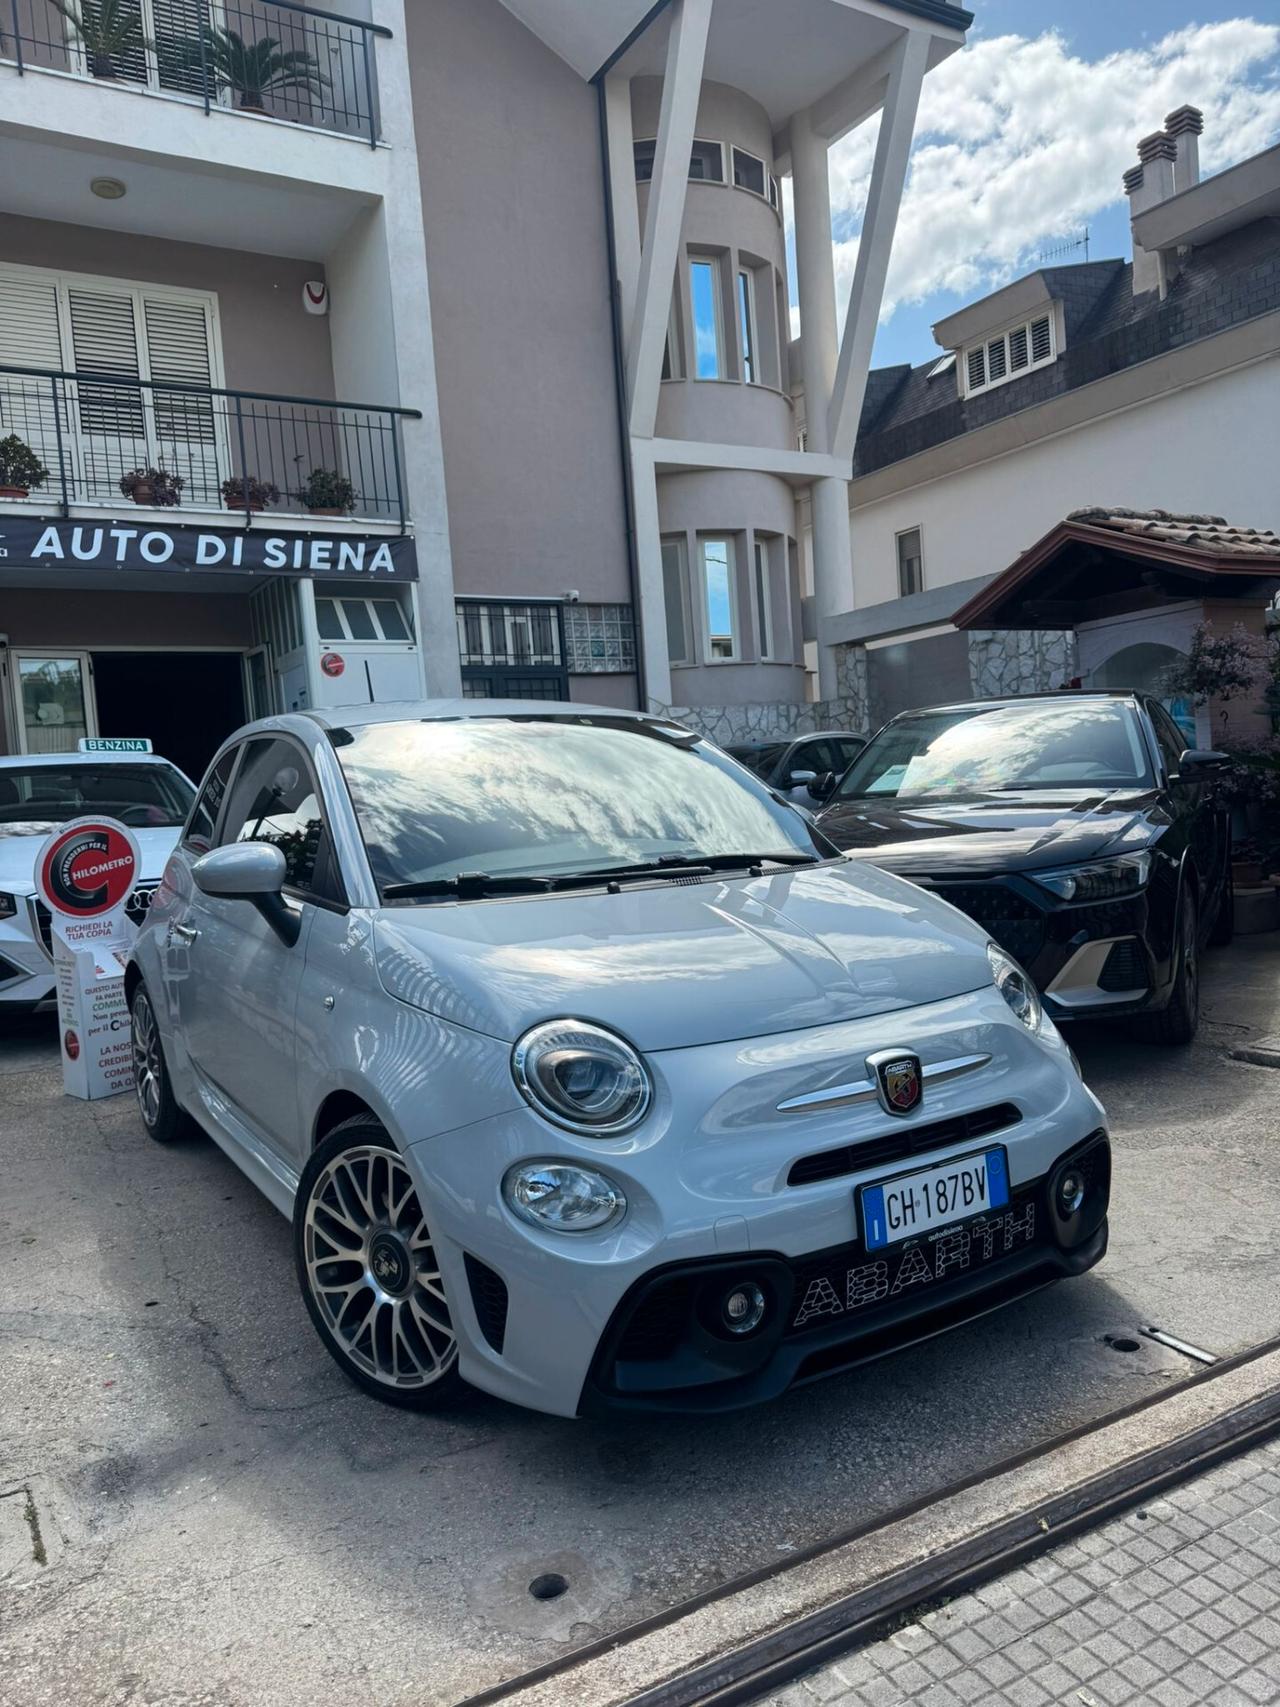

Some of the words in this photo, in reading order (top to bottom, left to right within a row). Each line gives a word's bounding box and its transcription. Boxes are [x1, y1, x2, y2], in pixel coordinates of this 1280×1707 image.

[30, 526, 175, 564] AUTO
[196, 534, 243, 566] DI
[263, 537, 396, 573] SIENA
[88, 740, 144, 751] BENZINA
[65, 922, 102, 934] RICHIEDI
[103, 920, 113, 928] LA
[67, 932, 85, 940] TUA
[86, 928, 112, 938] COPIA
[88, 1027, 101, 1036] per
[100, 1046, 111, 1055] LA
[111, 1080, 123, 1090] DA
[793, 1202, 1035, 1327] ABARTH
